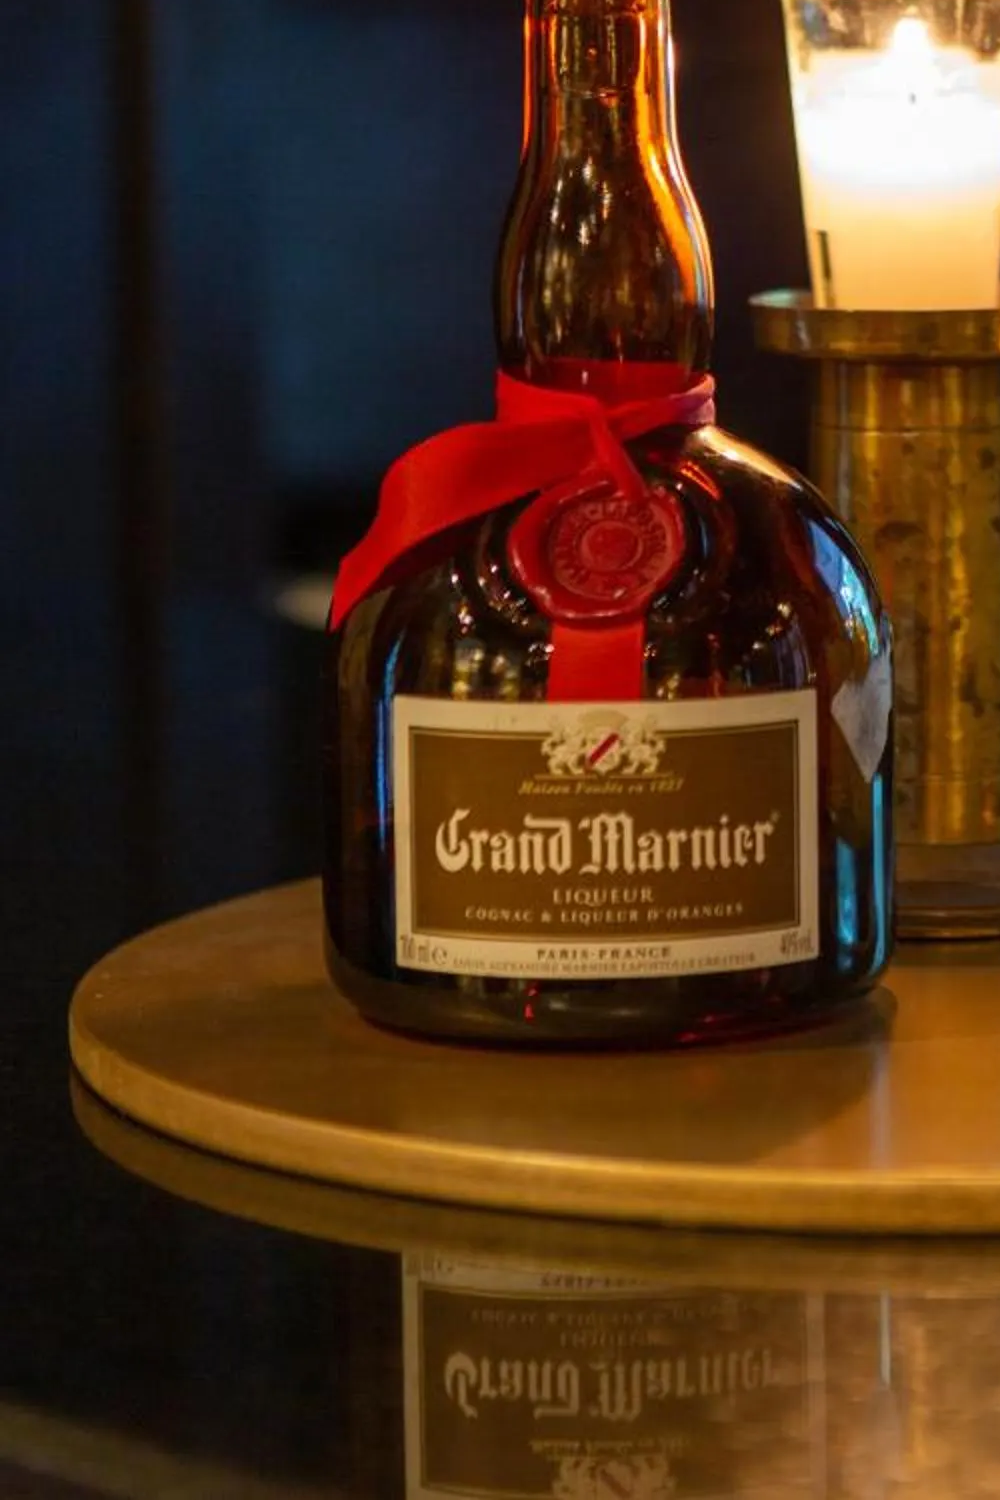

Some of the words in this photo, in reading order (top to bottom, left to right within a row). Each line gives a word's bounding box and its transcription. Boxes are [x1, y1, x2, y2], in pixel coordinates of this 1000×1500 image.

[435, 808, 574, 875] Grand
[577, 809, 775, 876] Marnier
[552, 887, 654, 906] LIQUEUR
[464, 905, 534, 923] COGNAC
[560, 909, 639, 925] LIQUEUR
[646, 902, 745, 921] D'ORANGES
